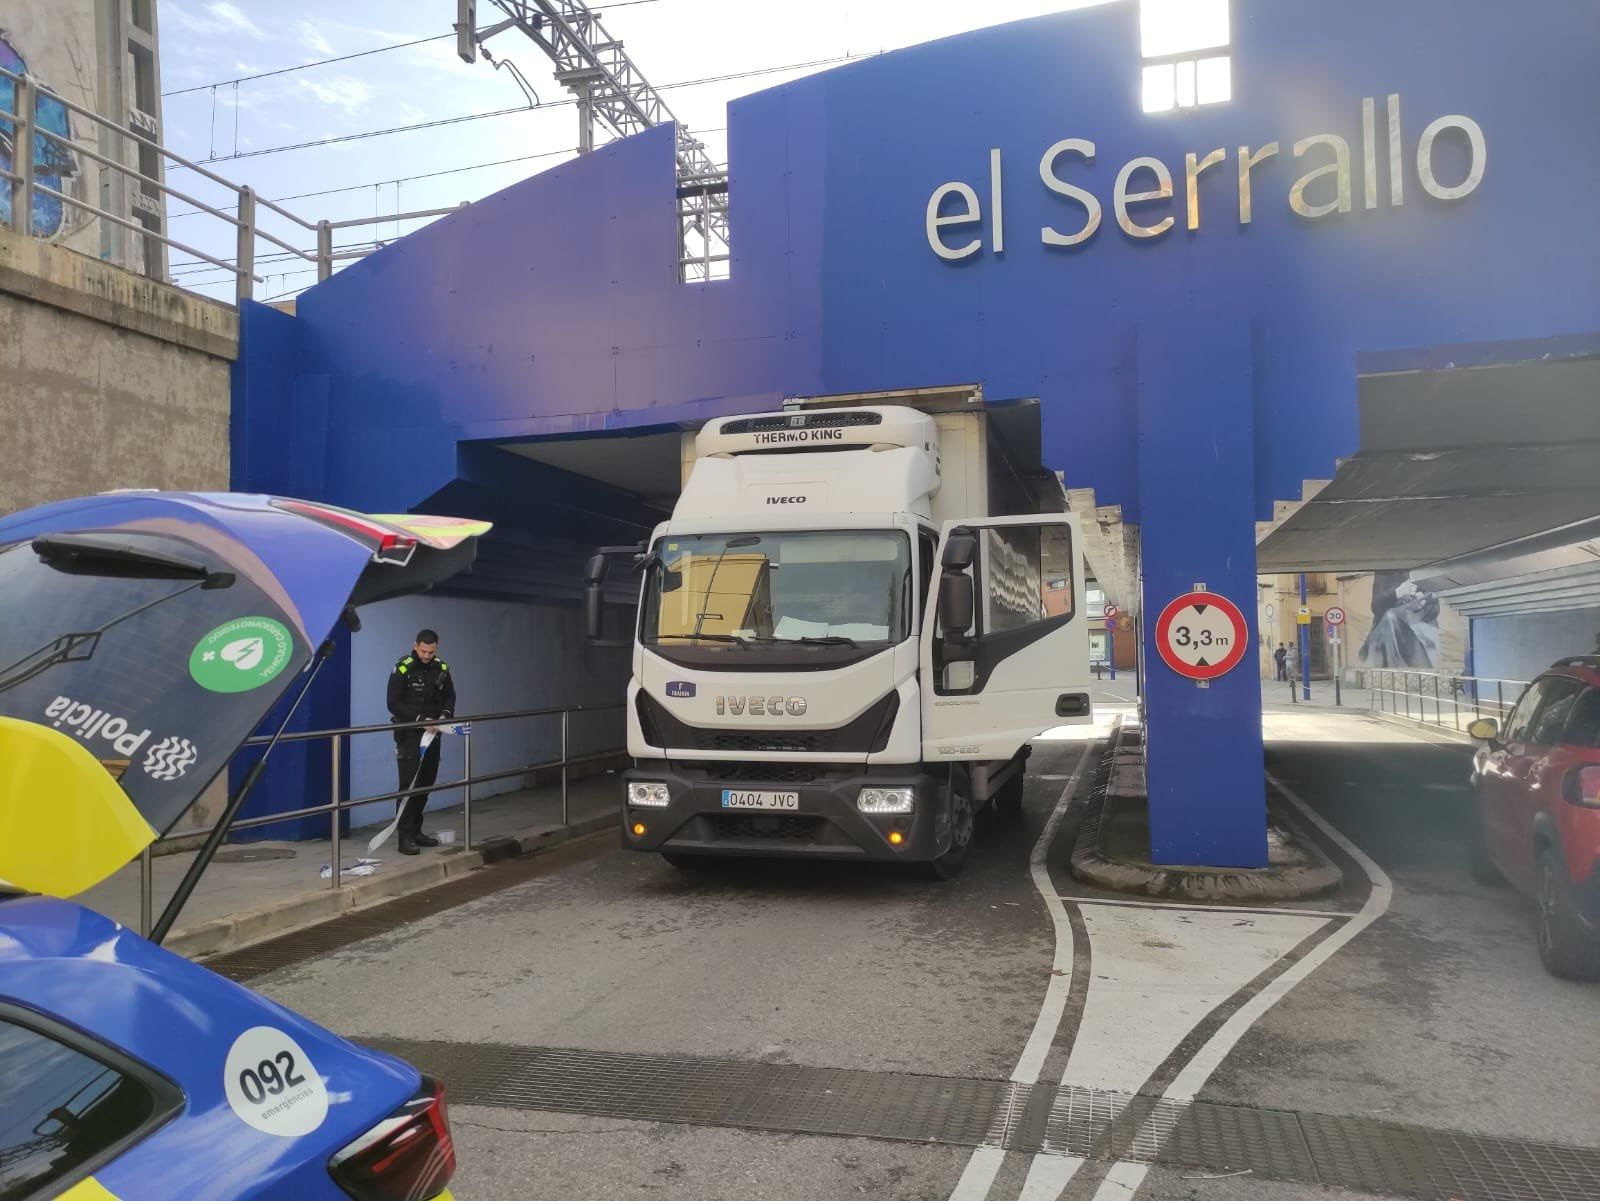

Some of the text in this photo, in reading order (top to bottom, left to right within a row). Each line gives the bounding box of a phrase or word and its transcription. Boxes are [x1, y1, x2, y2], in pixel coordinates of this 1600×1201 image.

[926, 93, 1487, 260] el Serrallo
[753, 429, 842, 444] THERMO KING
[766, 496, 807, 504] IVECO
[1329, 612, 1341, 620] 30
[1175, 626, 1229, 650] 3,3 m
[715, 695, 808, 716] IVECO
[45, 695, 152, 757] Policia
[730, 792, 763, 806] 0404
[769, 793, 795, 807] JVC
[239, 1050, 306, 1105] 092
